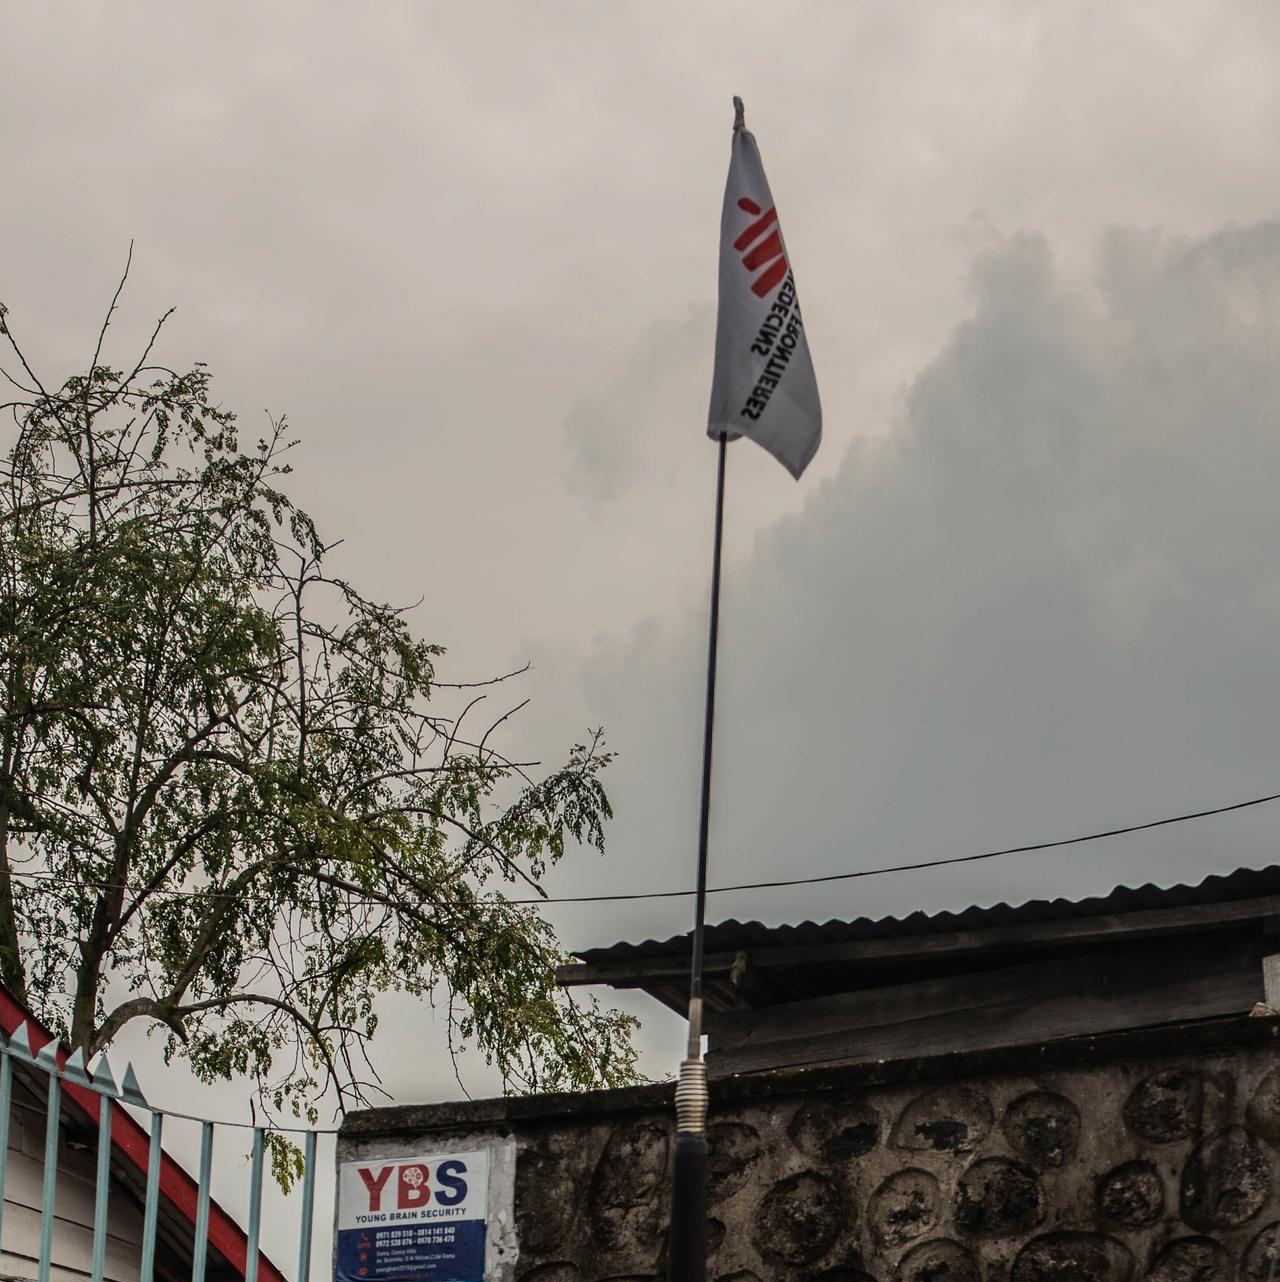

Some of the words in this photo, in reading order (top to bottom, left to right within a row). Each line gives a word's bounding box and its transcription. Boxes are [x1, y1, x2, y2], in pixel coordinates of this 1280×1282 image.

[358, 1160, 468, 1211] YBS
[356, 1214, 386, 1223] YOUNG
[421, 1208, 466, 1218] SECURITY
